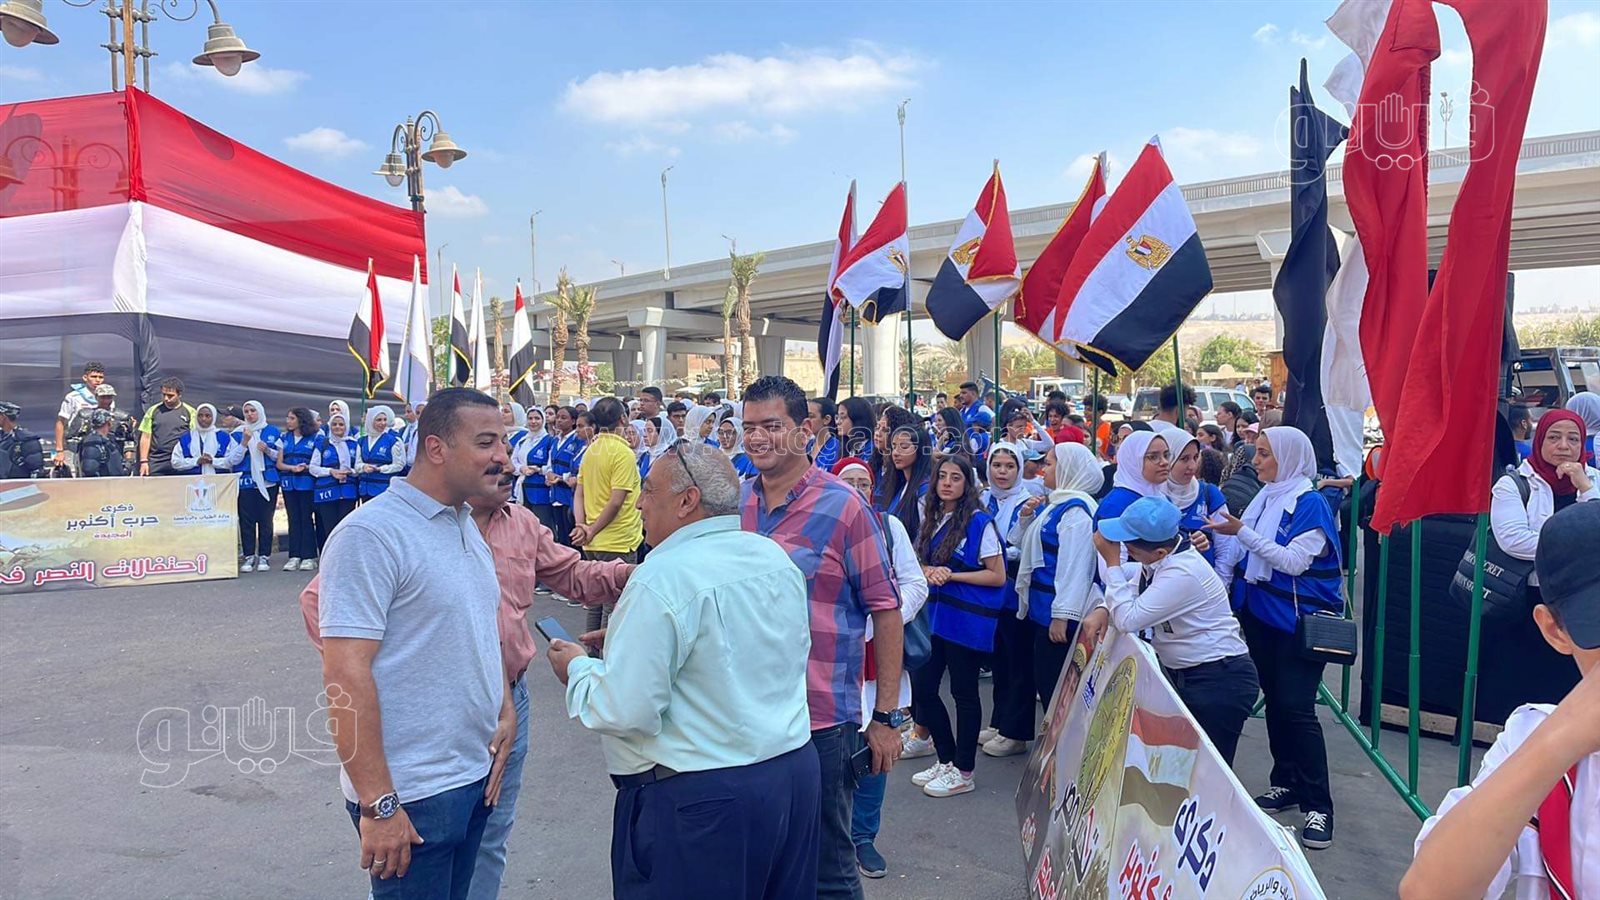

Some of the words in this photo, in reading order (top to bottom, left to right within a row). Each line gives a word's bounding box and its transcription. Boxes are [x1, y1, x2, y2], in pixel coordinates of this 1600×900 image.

[101, 503, 134, 513] ذكرى
[66, 513, 114, 531] أكتوبر
[122, 516, 158, 528] حرب
[35, 561, 94, 584] النصر
[1173, 799, 1225, 893] ذكرى
